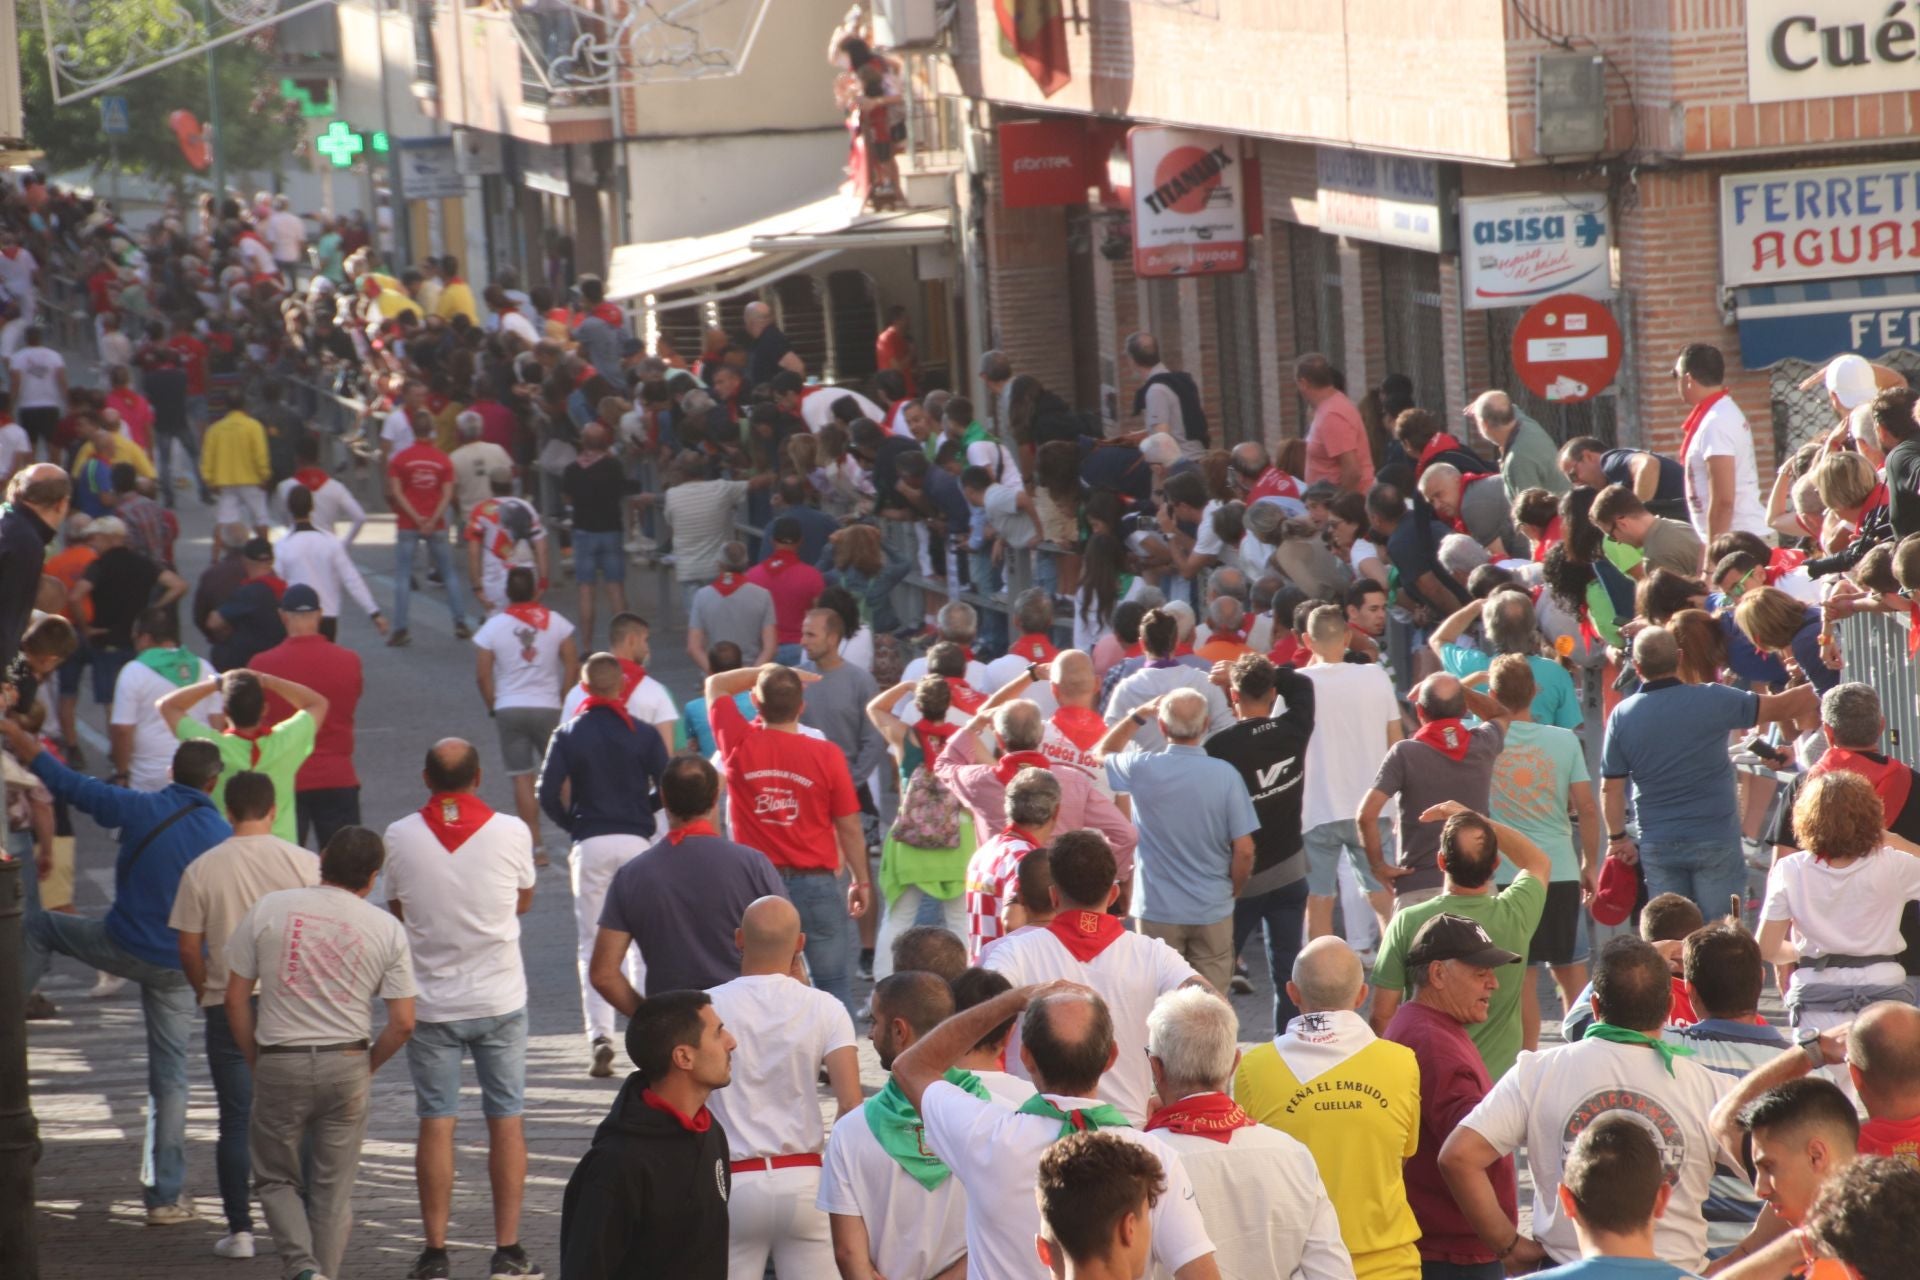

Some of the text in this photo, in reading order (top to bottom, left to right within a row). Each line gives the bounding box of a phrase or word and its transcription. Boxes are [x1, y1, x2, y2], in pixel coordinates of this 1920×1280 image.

[1770, 1, 1920, 72] Cué
[1144, 145, 1233, 215] TITANLUX
[1473, 215, 1565, 245] asisa
[1252, 721, 1278, 736] AITOR
[1042, 743, 1075, 763] TOROS
[1286, 1080, 1390, 1114] PEÑA EL EMBUDO
[1314, 1100, 1363, 1112] CUELLAR
[1569, 1092, 1676, 1137] CALIFORNIA
